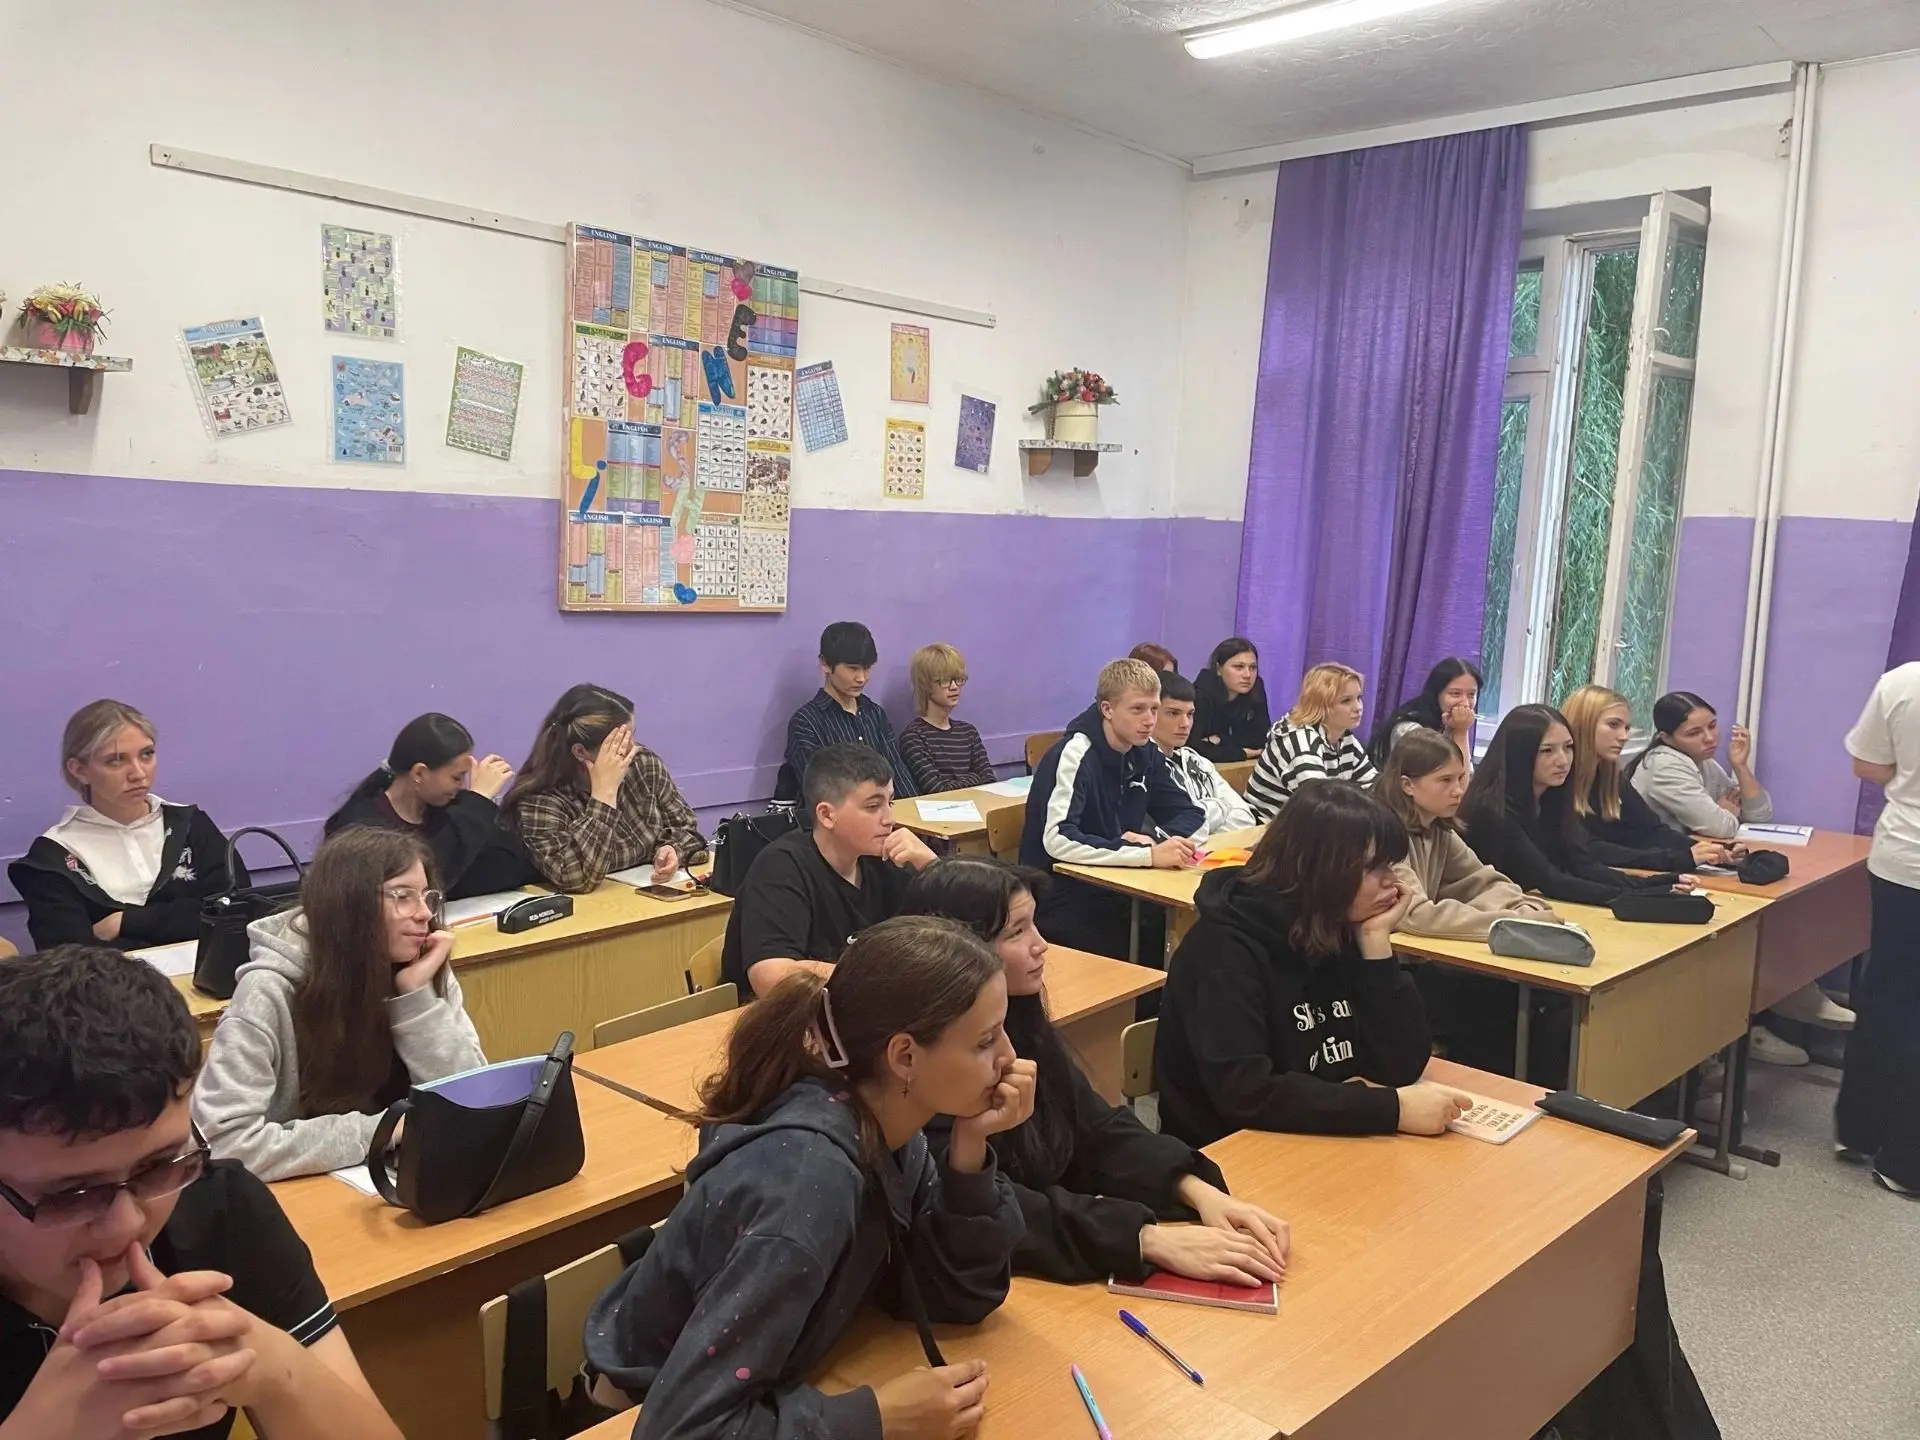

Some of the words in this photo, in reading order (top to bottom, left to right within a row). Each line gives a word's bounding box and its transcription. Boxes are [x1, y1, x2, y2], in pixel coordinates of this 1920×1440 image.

[591, 229, 617, 240] ENGLISH
[648, 241, 673, 252] ENGLISH
[700, 253, 724, 263] ENGLISH
[763, 267, 787, 277] ENGLISH
[662, 337, 686, 348] ENGLISH
[801, 366, 823, 376] ENGLISH
[622, 424, 649, 433] ENGLISH
[584, 513, 609, 522] ENGLISH
[639, 517, 663, 525] ENGLISH
